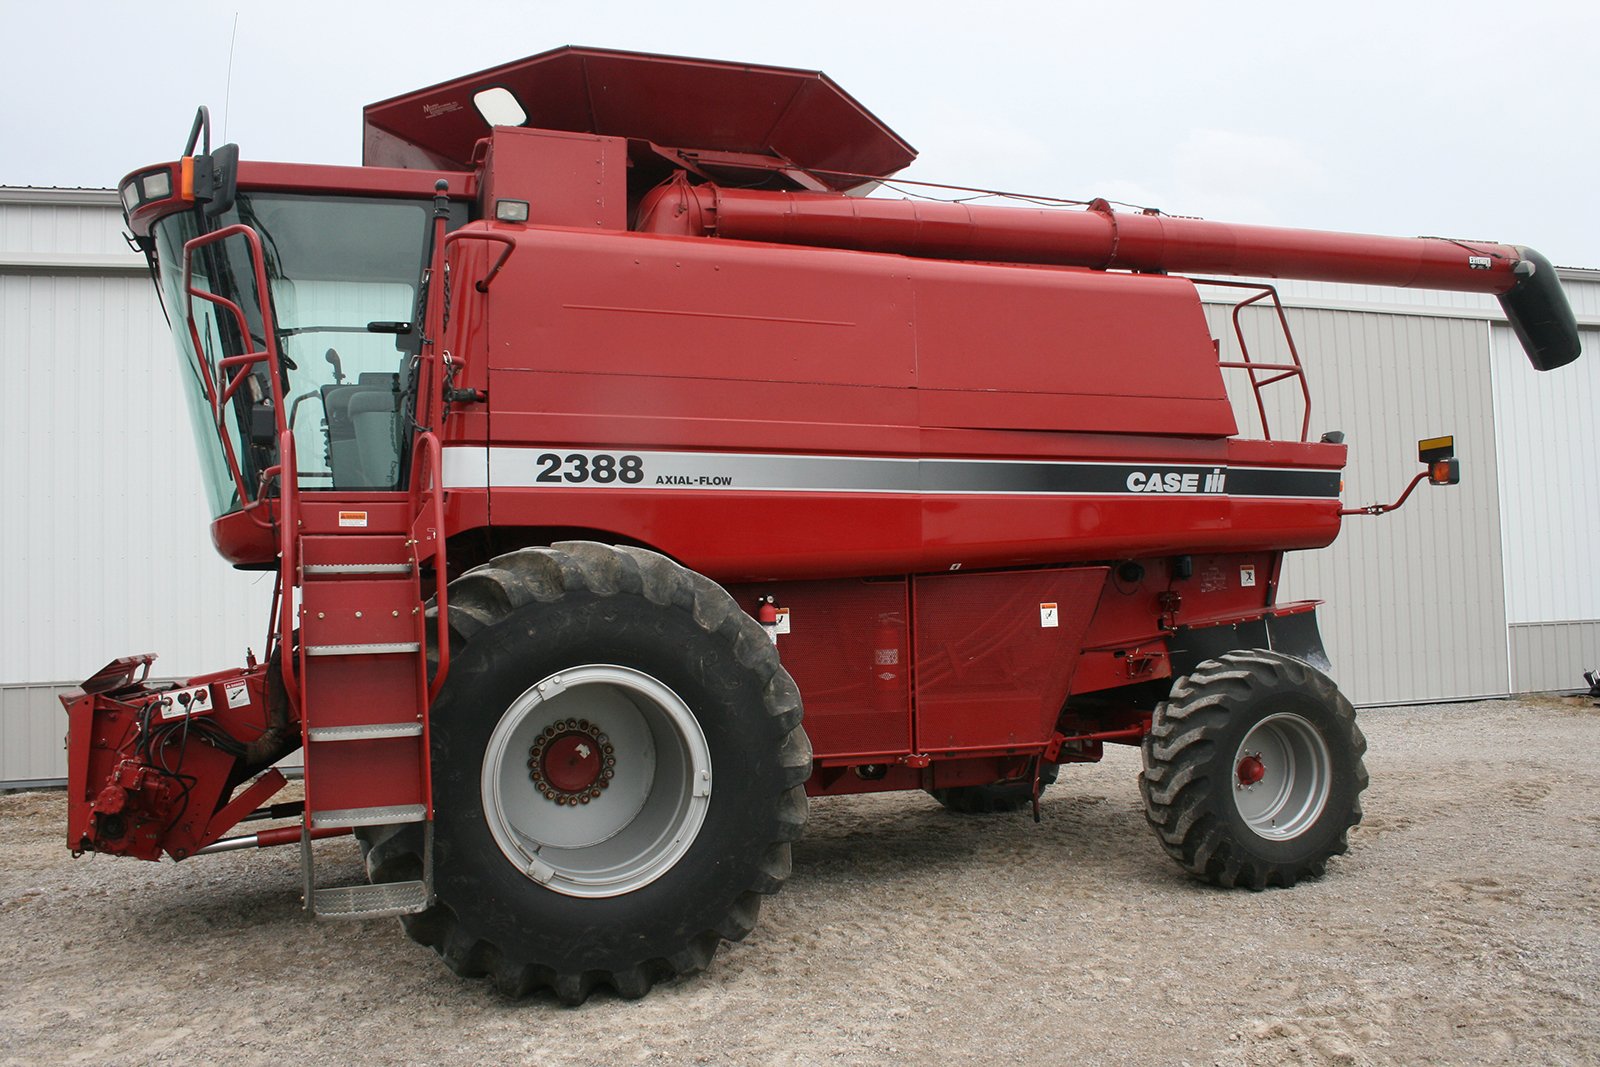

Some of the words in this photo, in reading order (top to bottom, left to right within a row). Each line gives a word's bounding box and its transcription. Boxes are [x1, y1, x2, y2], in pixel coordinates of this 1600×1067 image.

[536, 453, 644, 484] 2388
[655, 475, 732, 486] AXIAL-FLOW
[1126, 471, 1199, 493] CASE
